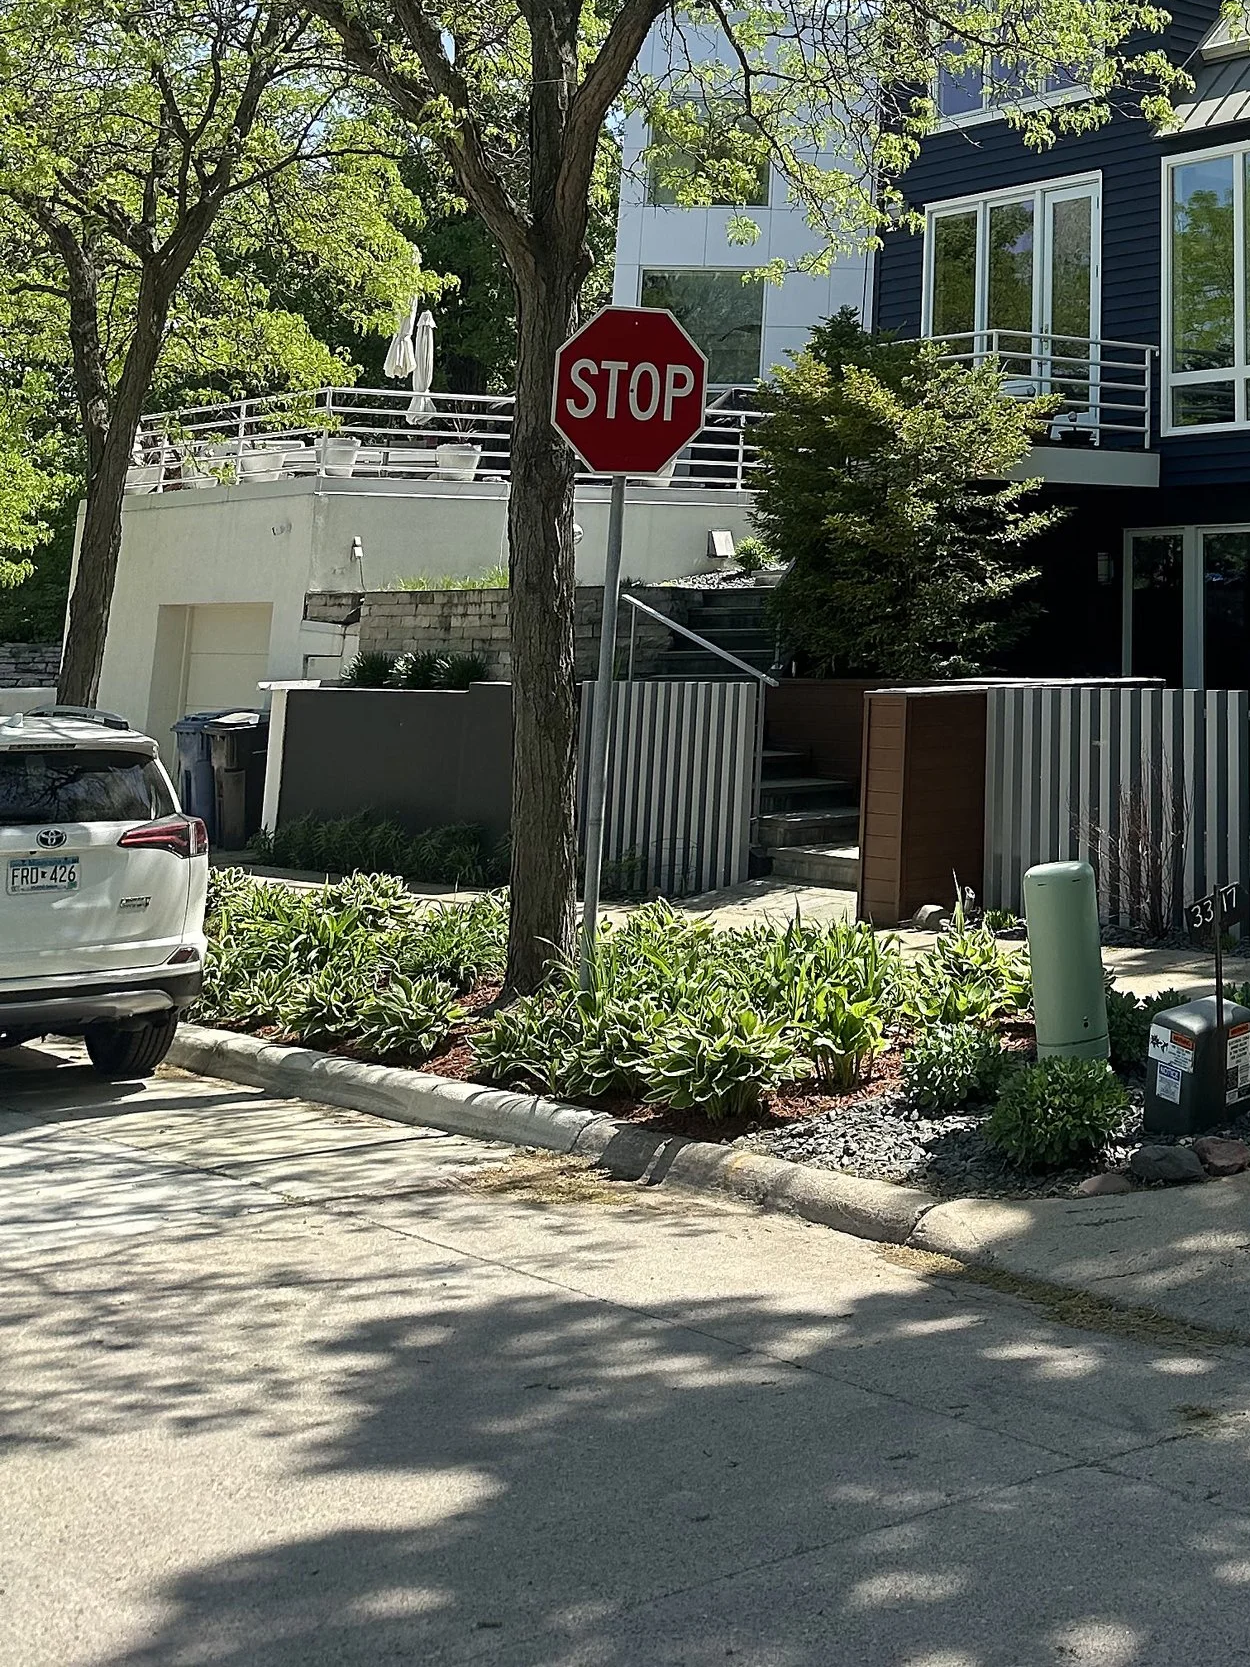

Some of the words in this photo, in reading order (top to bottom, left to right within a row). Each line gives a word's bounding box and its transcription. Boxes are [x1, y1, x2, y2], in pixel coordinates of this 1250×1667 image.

[566, 358, 695, 422] STOP
[11, 867, 39, 885] FRD
[50, 865, 76, 882] 426
